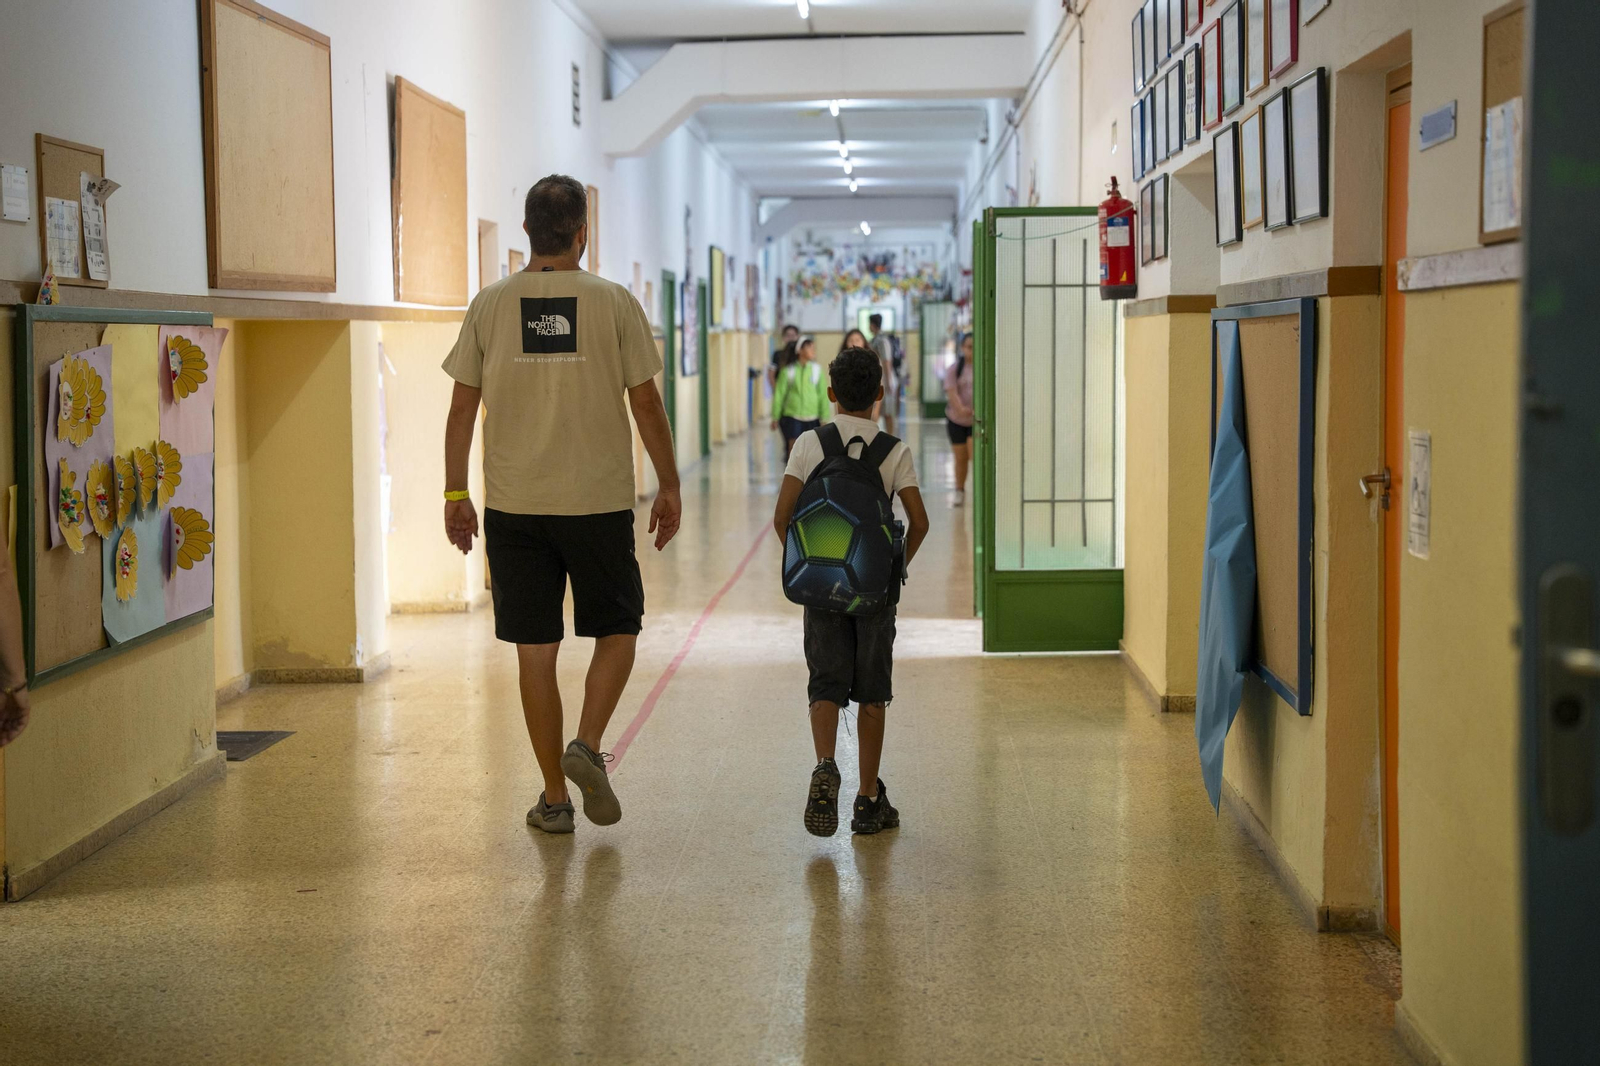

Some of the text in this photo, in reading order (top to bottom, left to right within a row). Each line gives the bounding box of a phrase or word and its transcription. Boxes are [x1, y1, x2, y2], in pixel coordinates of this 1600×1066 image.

[540, 314, 556, 322] THE
[527, 321, 556, 329] NORTH
[536, 328, 556, 336] FACE
